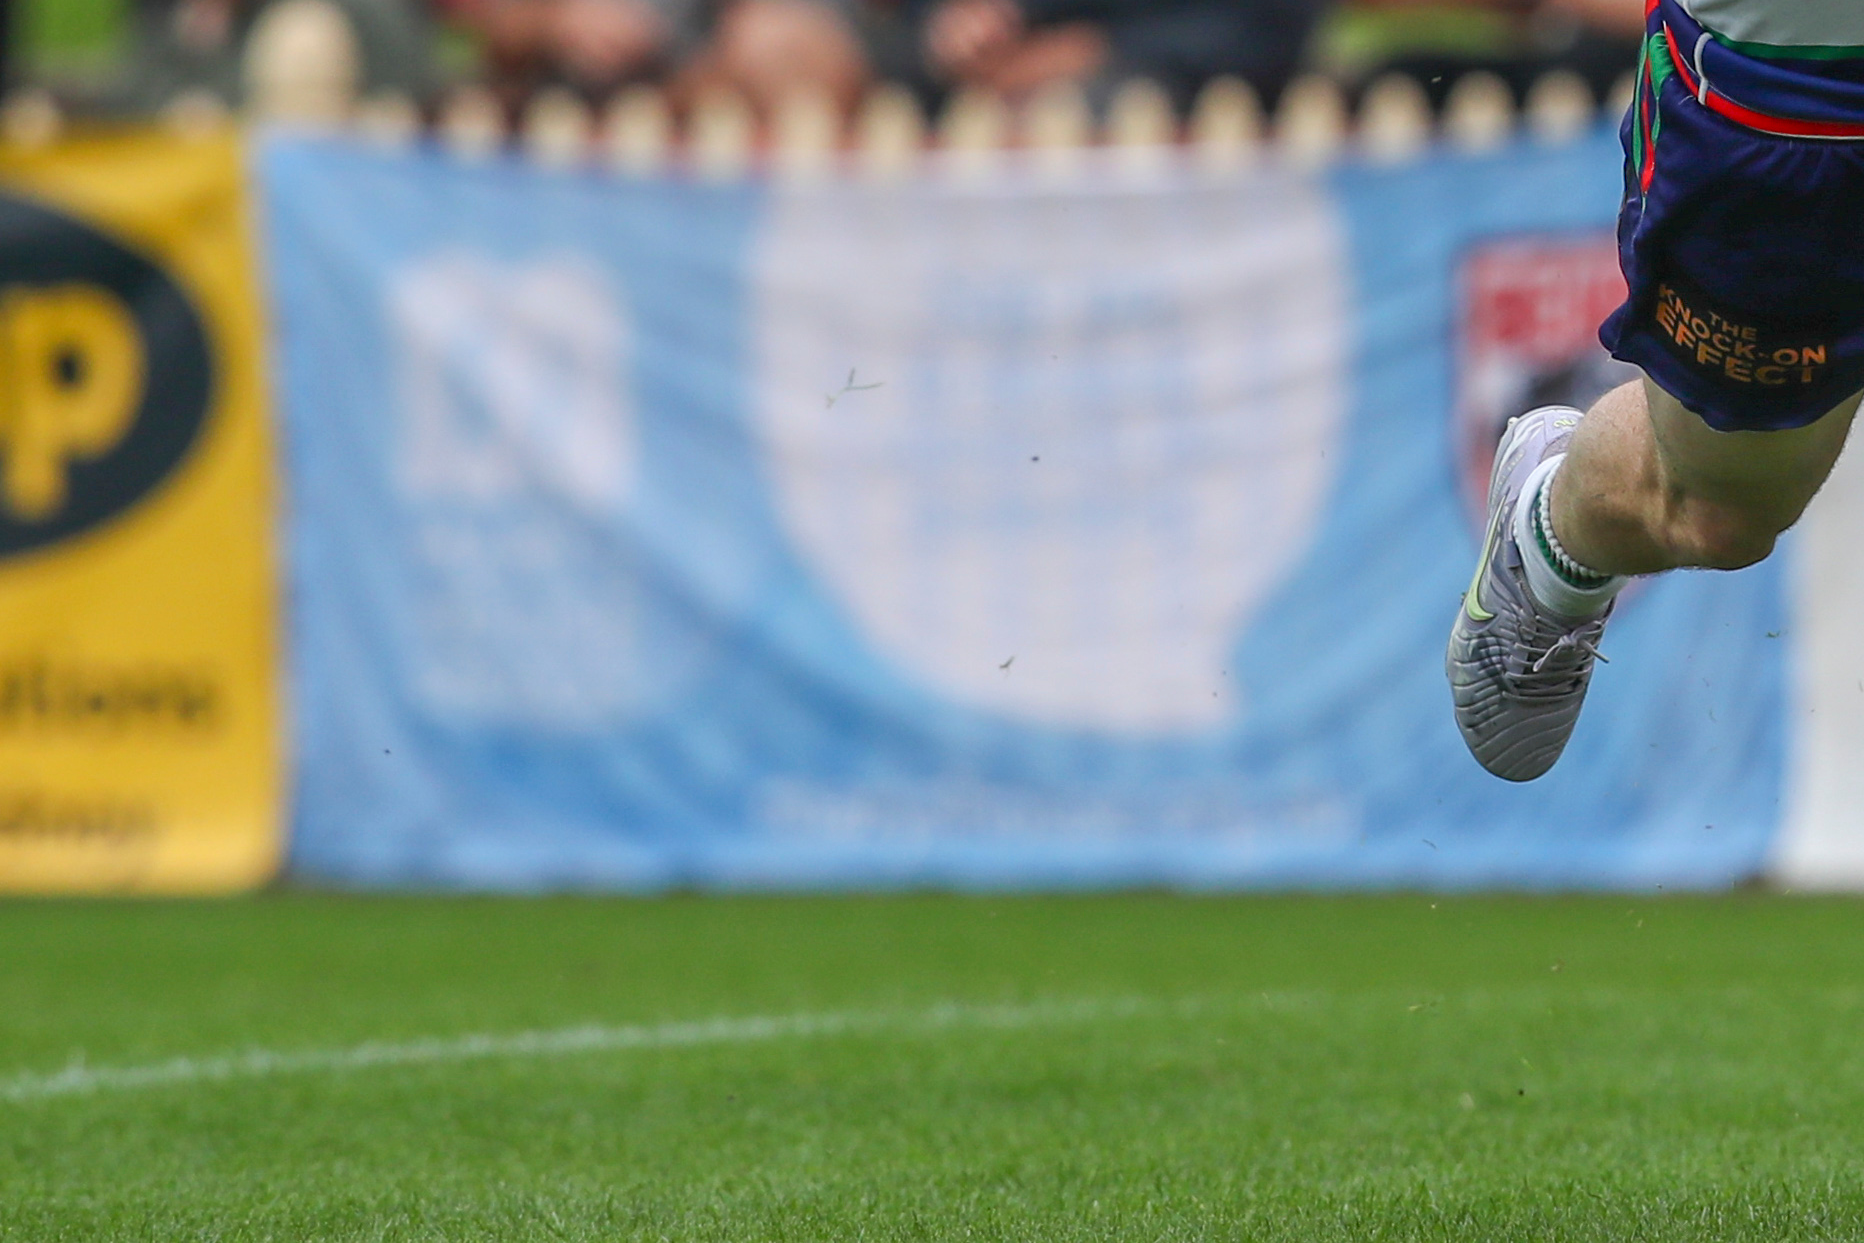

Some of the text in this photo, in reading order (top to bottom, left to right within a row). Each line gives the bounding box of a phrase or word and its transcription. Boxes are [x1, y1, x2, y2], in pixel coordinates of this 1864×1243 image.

[1656, 301, 1822, 386] EFFECT
[1658, 283, 1827, 367] KNOCK-ON
[1708, 310, 1758, 341] THE
